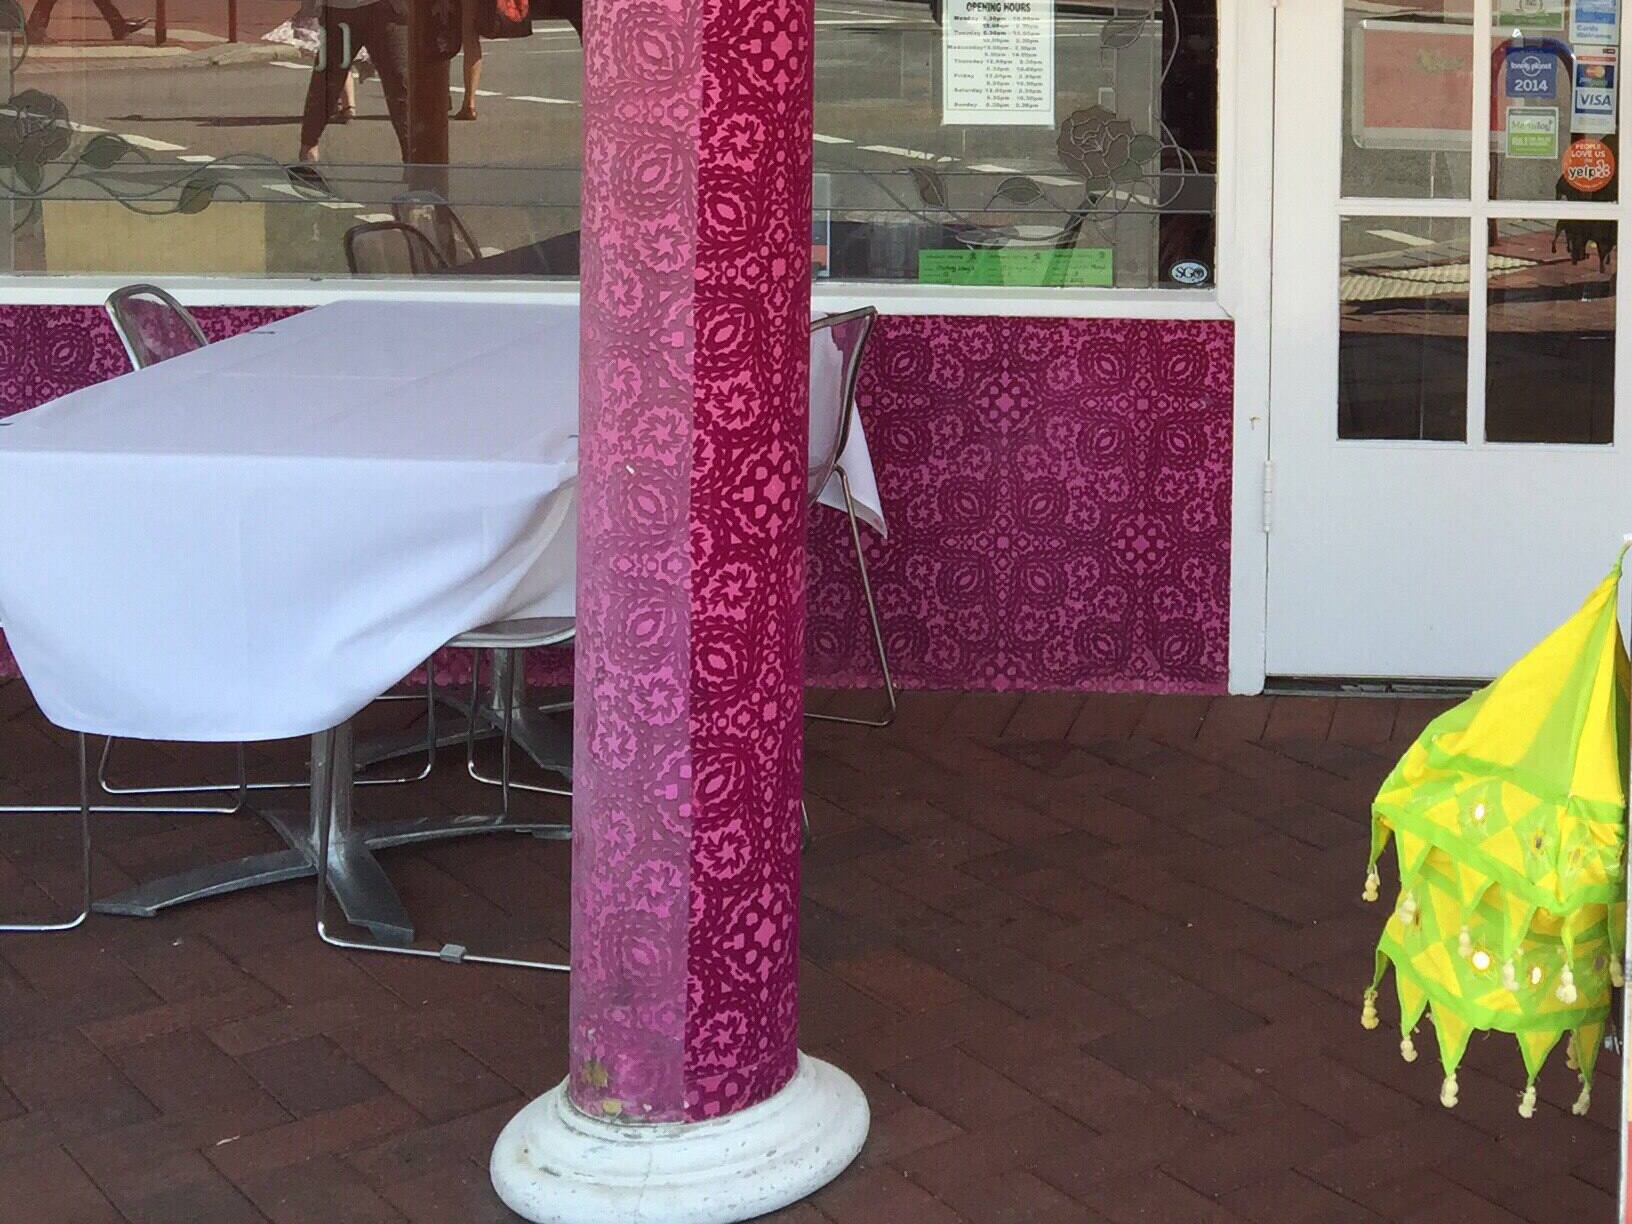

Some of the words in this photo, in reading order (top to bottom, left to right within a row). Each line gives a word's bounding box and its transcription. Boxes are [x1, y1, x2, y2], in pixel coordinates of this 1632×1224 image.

[966, 2, 1002, 13] OPENING
[1004, 2, 1031, 13] HOURS
[1514, 79, 1549, 92] 2014
[1580, 94, 1612, 106] VISA
[1571, 150, 1593, 158] LOVE
[1594, 150, 1606, 158] US
[1568, 163, 1597, 179] yelp
